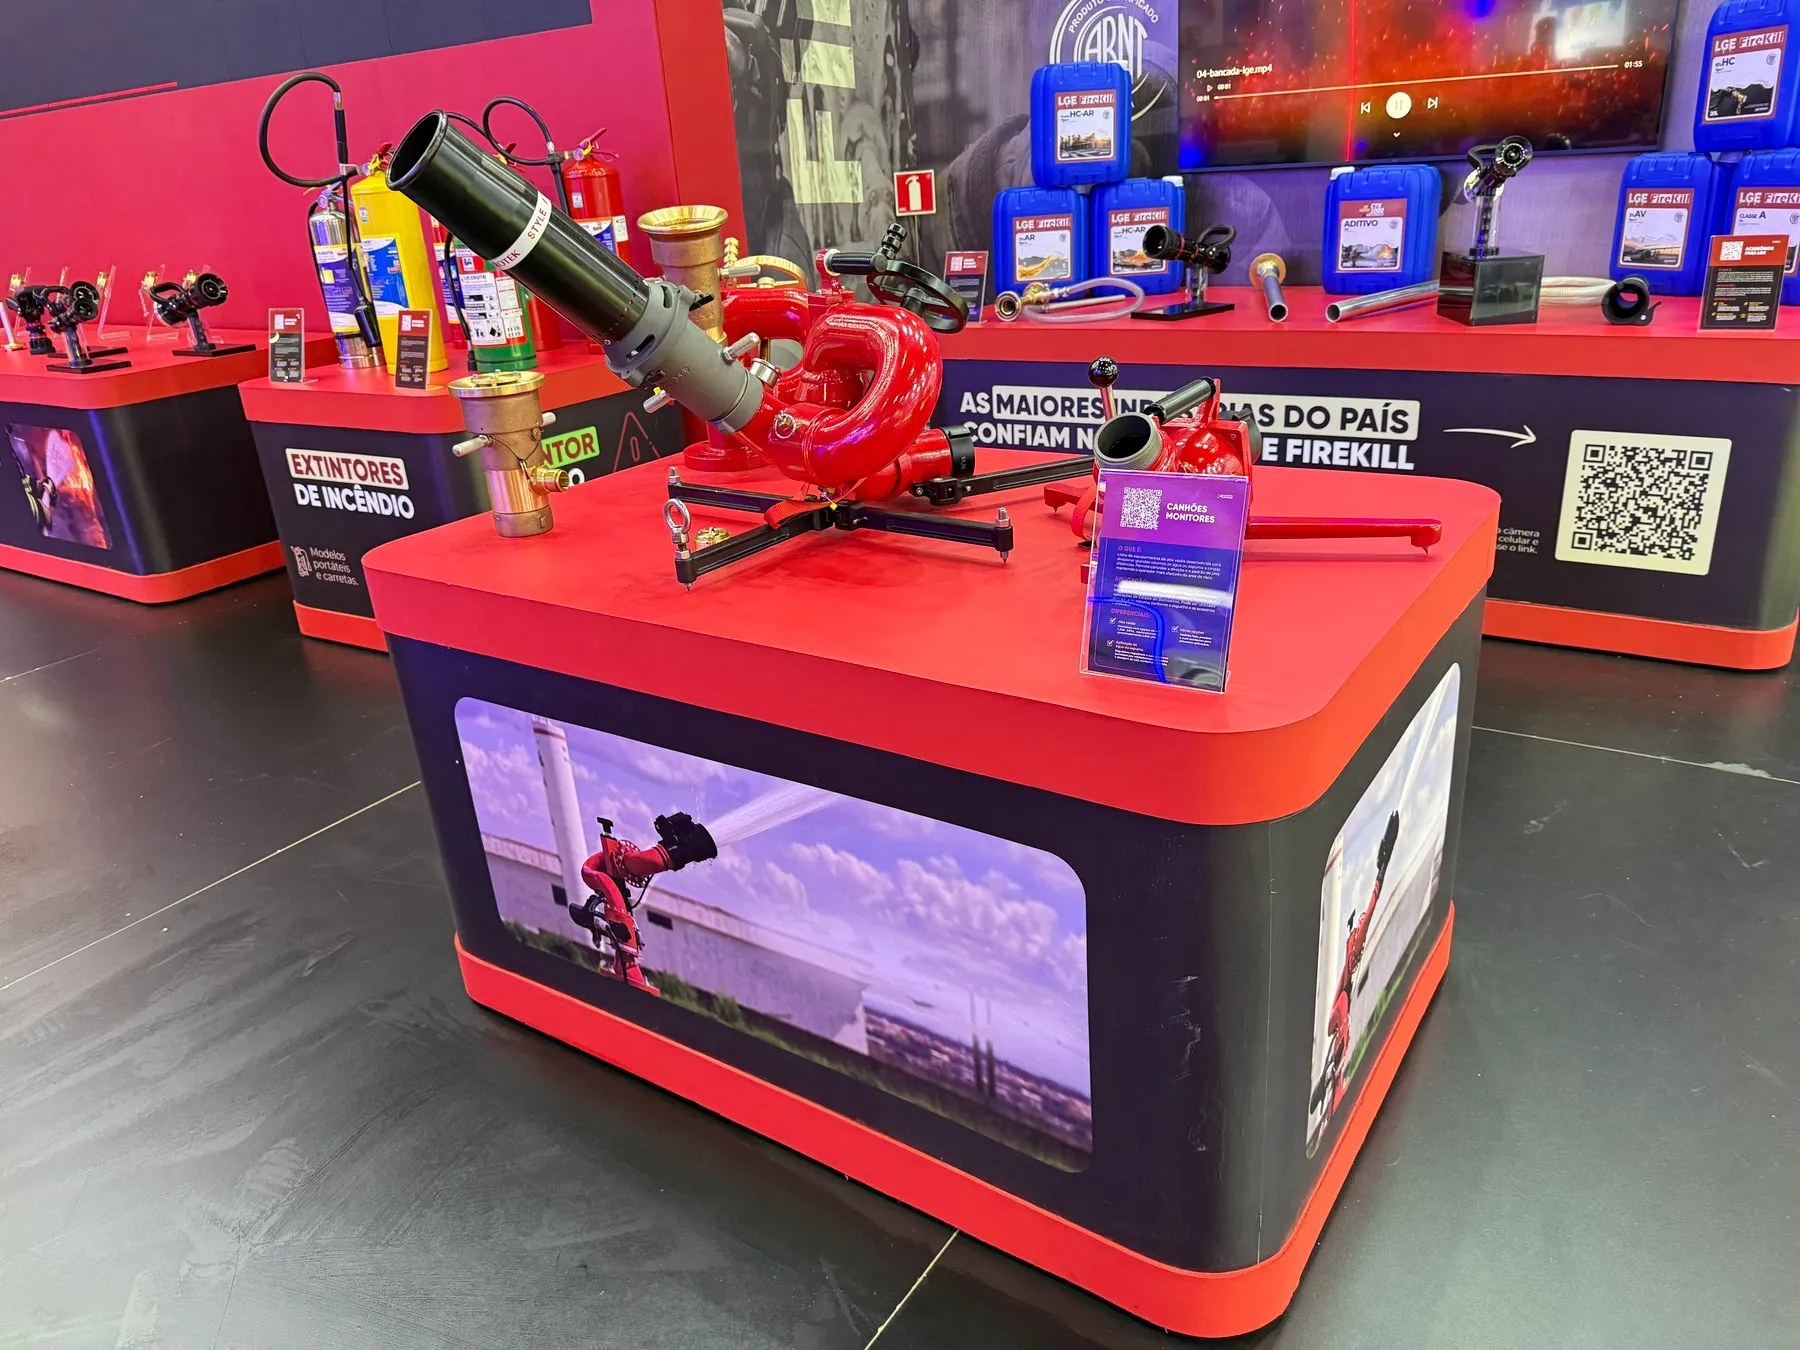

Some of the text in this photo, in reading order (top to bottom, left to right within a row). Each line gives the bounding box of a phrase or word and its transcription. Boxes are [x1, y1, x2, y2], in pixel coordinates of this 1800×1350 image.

[1714, 31, 1785, 53] LGE FireKill
[1624, 60, 1643, 69] 01:55
[1722, 57, 1735, 67] HC
[1196, 63, 1273, 79] 04-bancada-lge.mp4
[1057, 96, 1078, 106] LGE
[1069, 110, 1095, 118] HC-AR
[1629, 193, 1691, 206] LGE FireKill
[1739, 192, 1800, 205] LGE FireKi
[1111, 213, 1130, 223] LGE
[1635, 210, 1647, 218] AV
[1759, 211, 1766, 219] A
[527, 208, 547, 240] STYLE
[1015, 220, 1035, 230] LGE
[1122, 226, 1146, 234] HC-AR
[960, 391, 991, 415] AS
[996, 394, 1104, 419] MAIORES
[1283, 404, 1331, 430] DO
[1339, 402, 1410, 434] PAÍS
[543, 432, 597, 466] NTOR
[963, 421, 1071, 449] CONFIAM
[1077, 427, 1095, 451] N
[1285, 438, 1415, 470] FIREKILL
[290, 453, 404, 487] EXTINTORES
[293, 483, 415, 520] DE INCÊNDIO
[1166, 502, 1208, 513] CANHÕES
[1165, 512, 1216, 524] MONITORES
[1503, 527, 1540, 538] câmera
[1498, 536, 1531, 545] celular
[309, 547, 347, 561] Modelos
[1518, 545, 1538, 554] link.
[313, 560, 351, 574] portáteis
[316, 572, 359, 586] e carretas.
